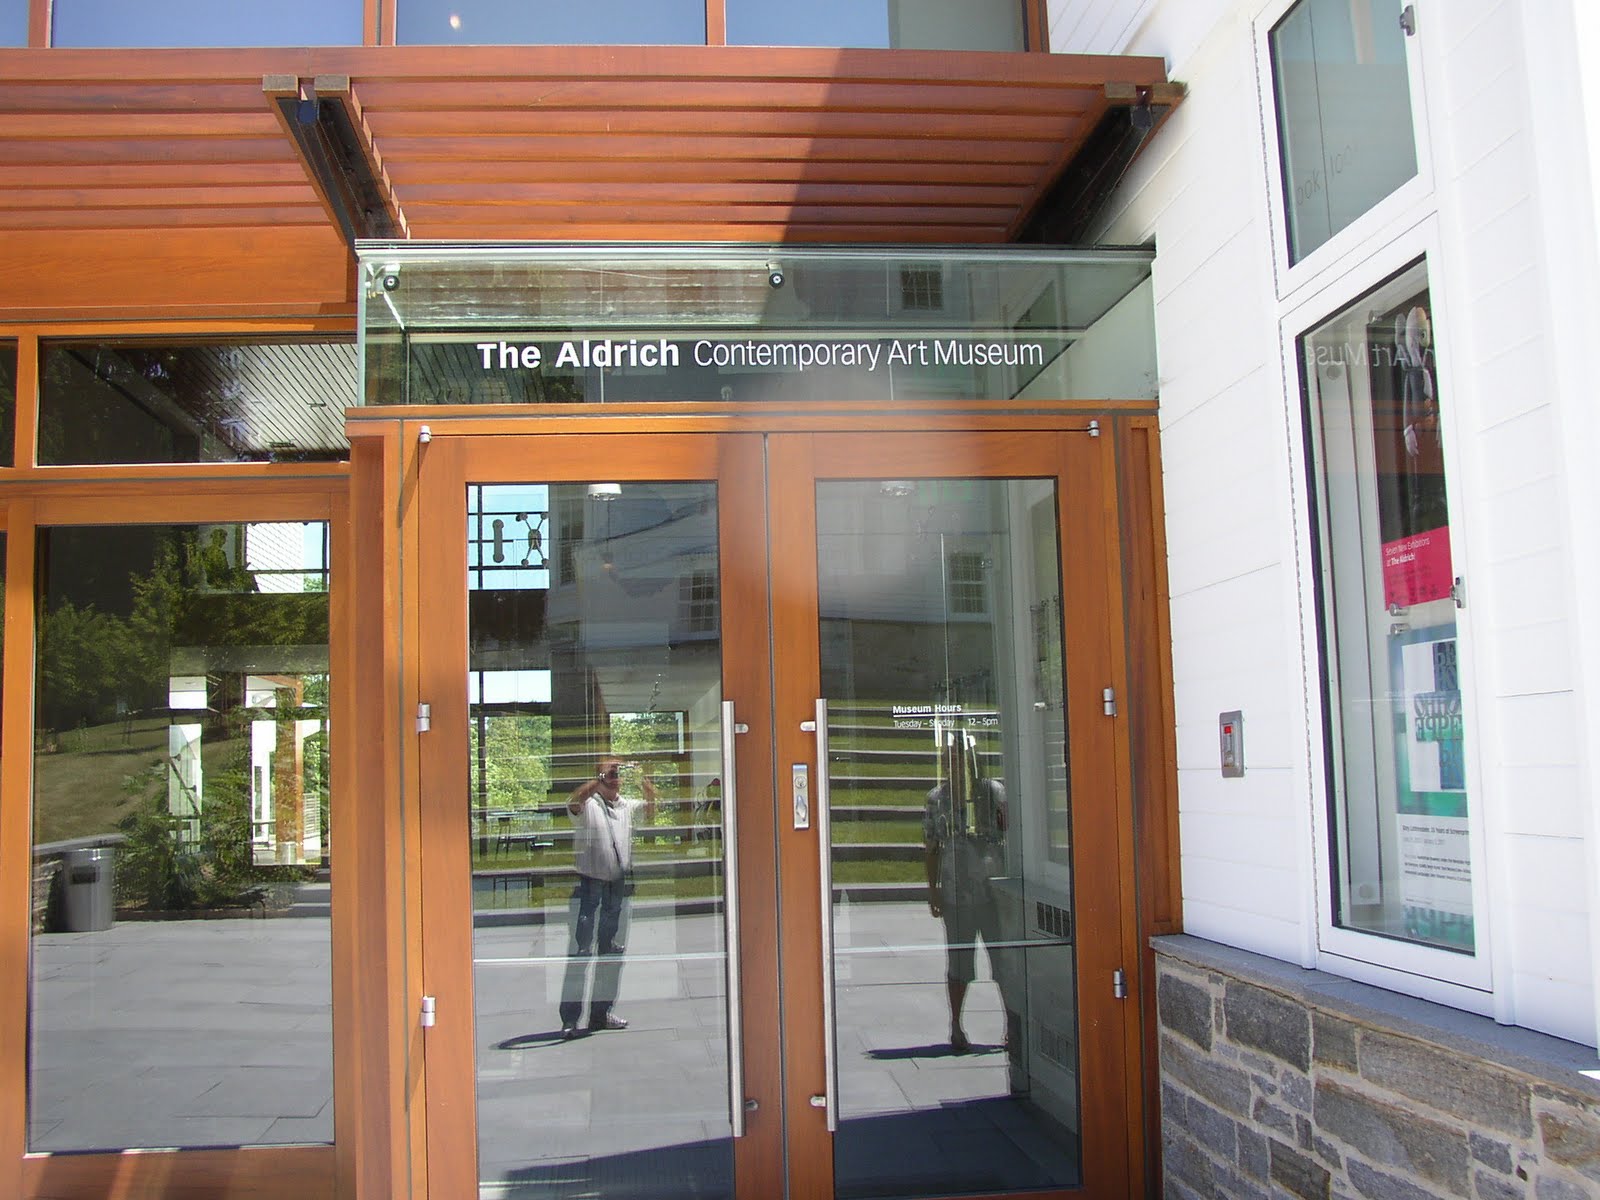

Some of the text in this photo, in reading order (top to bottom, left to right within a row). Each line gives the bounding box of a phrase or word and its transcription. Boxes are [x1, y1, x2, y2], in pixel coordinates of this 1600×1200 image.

[477, 338, 1043, 372] The Aldrich Contemporary Art Museum
[893, 704, 962, 714] Museum Hours
[894, 719, 922, 729] Tuesday
